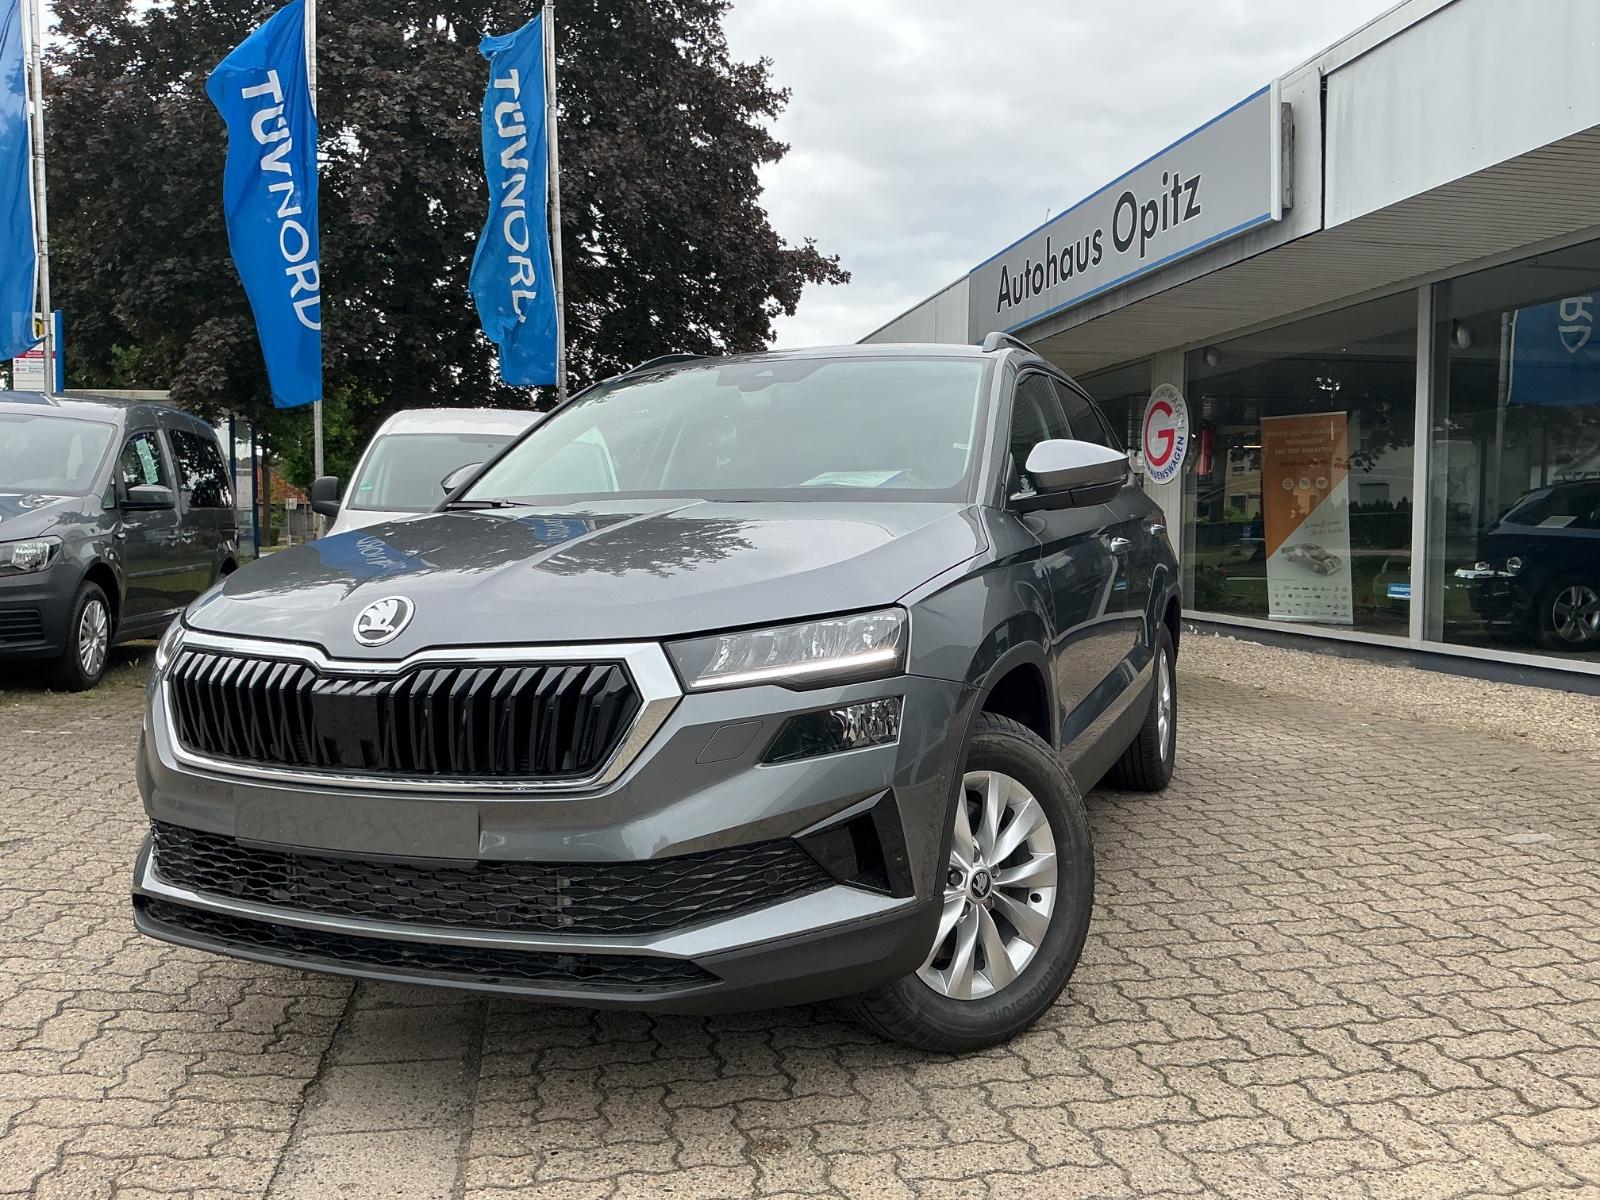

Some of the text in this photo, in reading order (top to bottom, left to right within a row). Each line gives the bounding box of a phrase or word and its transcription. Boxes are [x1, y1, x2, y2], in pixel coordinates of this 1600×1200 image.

[996, 171, 1201, 313] Autohaus Opitz
[1145, 401, 1175, 467] G
